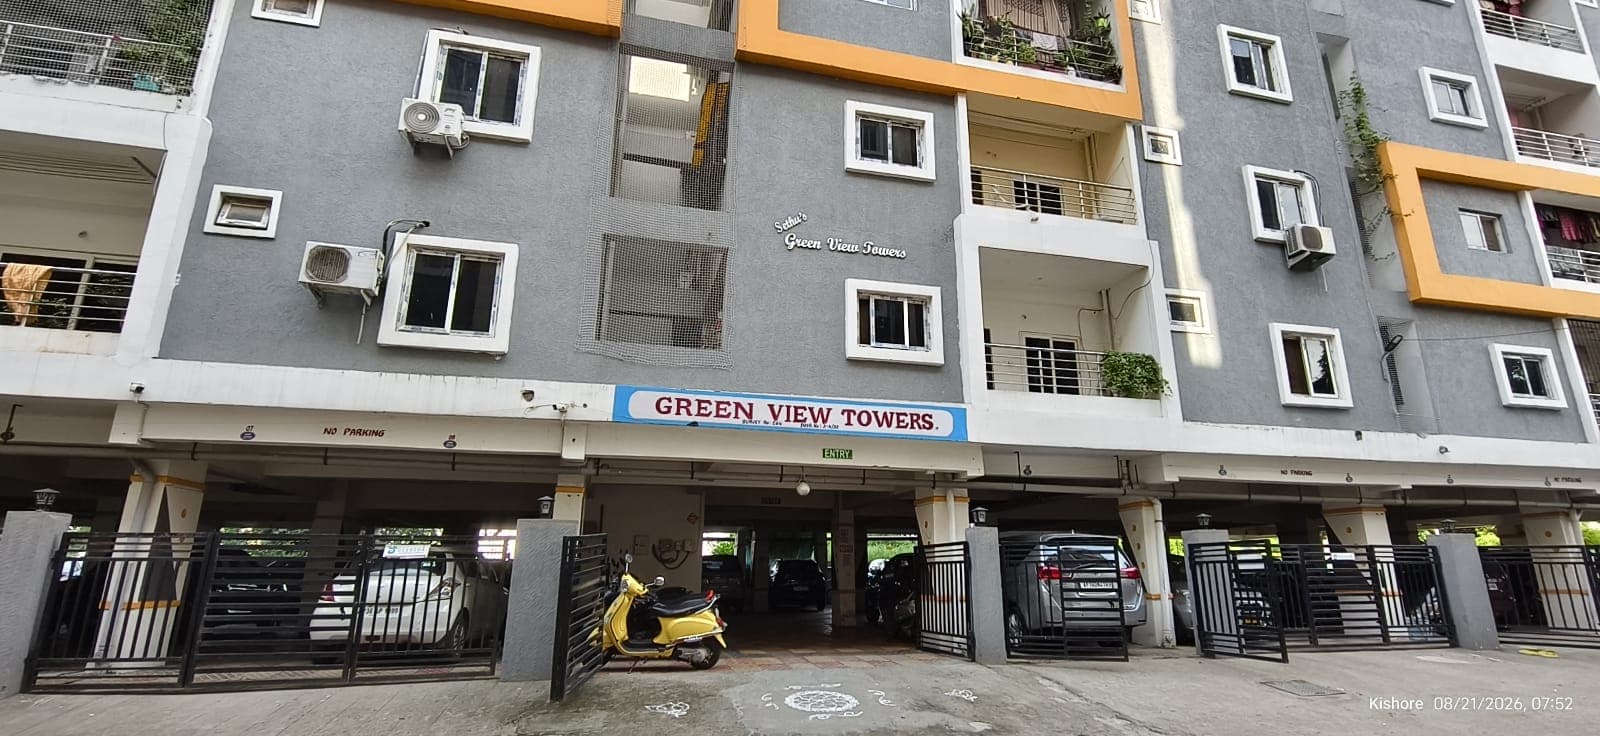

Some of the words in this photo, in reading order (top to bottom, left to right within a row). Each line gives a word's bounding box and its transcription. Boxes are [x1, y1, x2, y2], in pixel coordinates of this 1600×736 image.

[774, 212, 808, 233] Sethu's
[784, 232, 821, 250] Green
[827, 237, 859, 252] View
[862, 241, 907, 258] Towers
[655, 396, 753, 419] GREEN
[767, 403, 832, 425] VIEW
[323, 427, 337, 435] NO
[343, 427, 385, 437] PARKING
[824, 448, 850, 459] ENTRY
